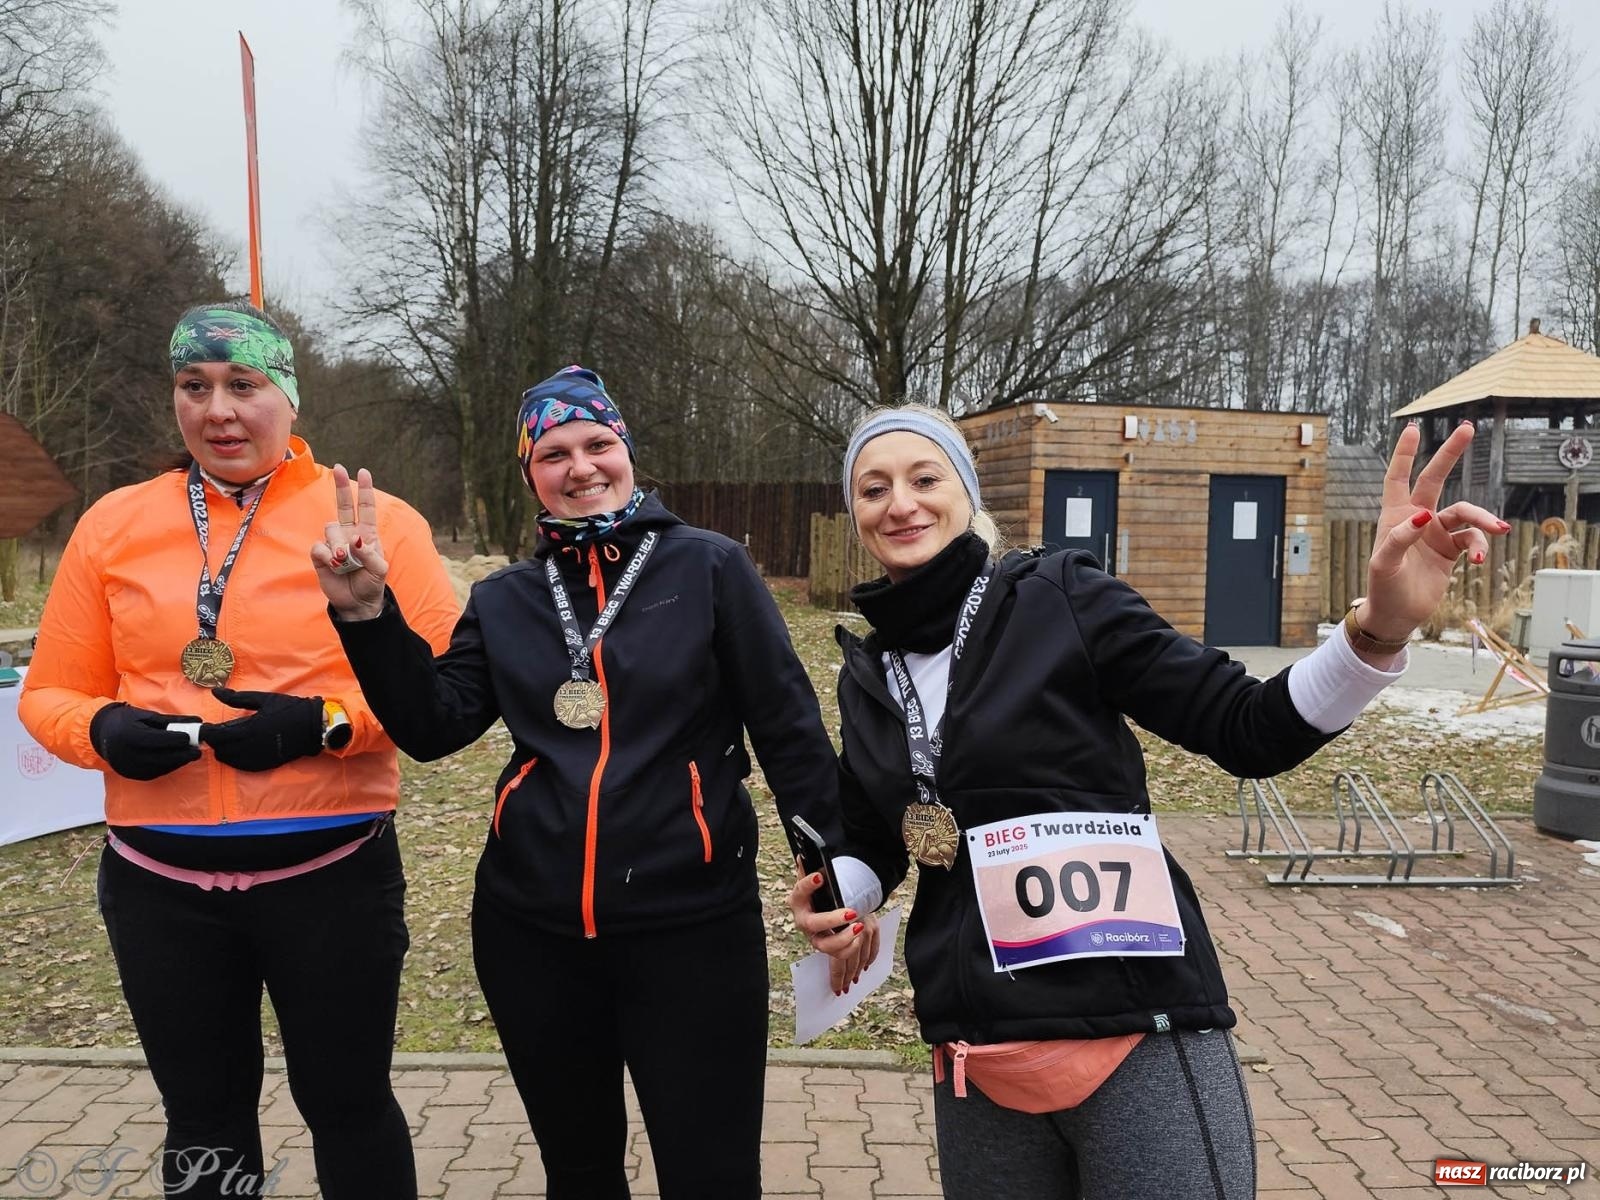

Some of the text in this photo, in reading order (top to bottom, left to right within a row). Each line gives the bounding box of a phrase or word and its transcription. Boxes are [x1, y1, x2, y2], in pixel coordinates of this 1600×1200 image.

[553, 584, 569, 609] BIEG
[590, 530, 659, 640] 13 BIEG TWARDZIELA
[561, 609, 573, 622] 13
[906, 697, 922, 723] BIEG
[910, 725, 924, 741] 13
[985, 820, 1142, 847] BIEG Twardziela
[987, 843, 1028, 858] 23 luty 2025
[1015, 860, 1132, 918] 007
[1105, 932, 1150, 943] Racibórz
